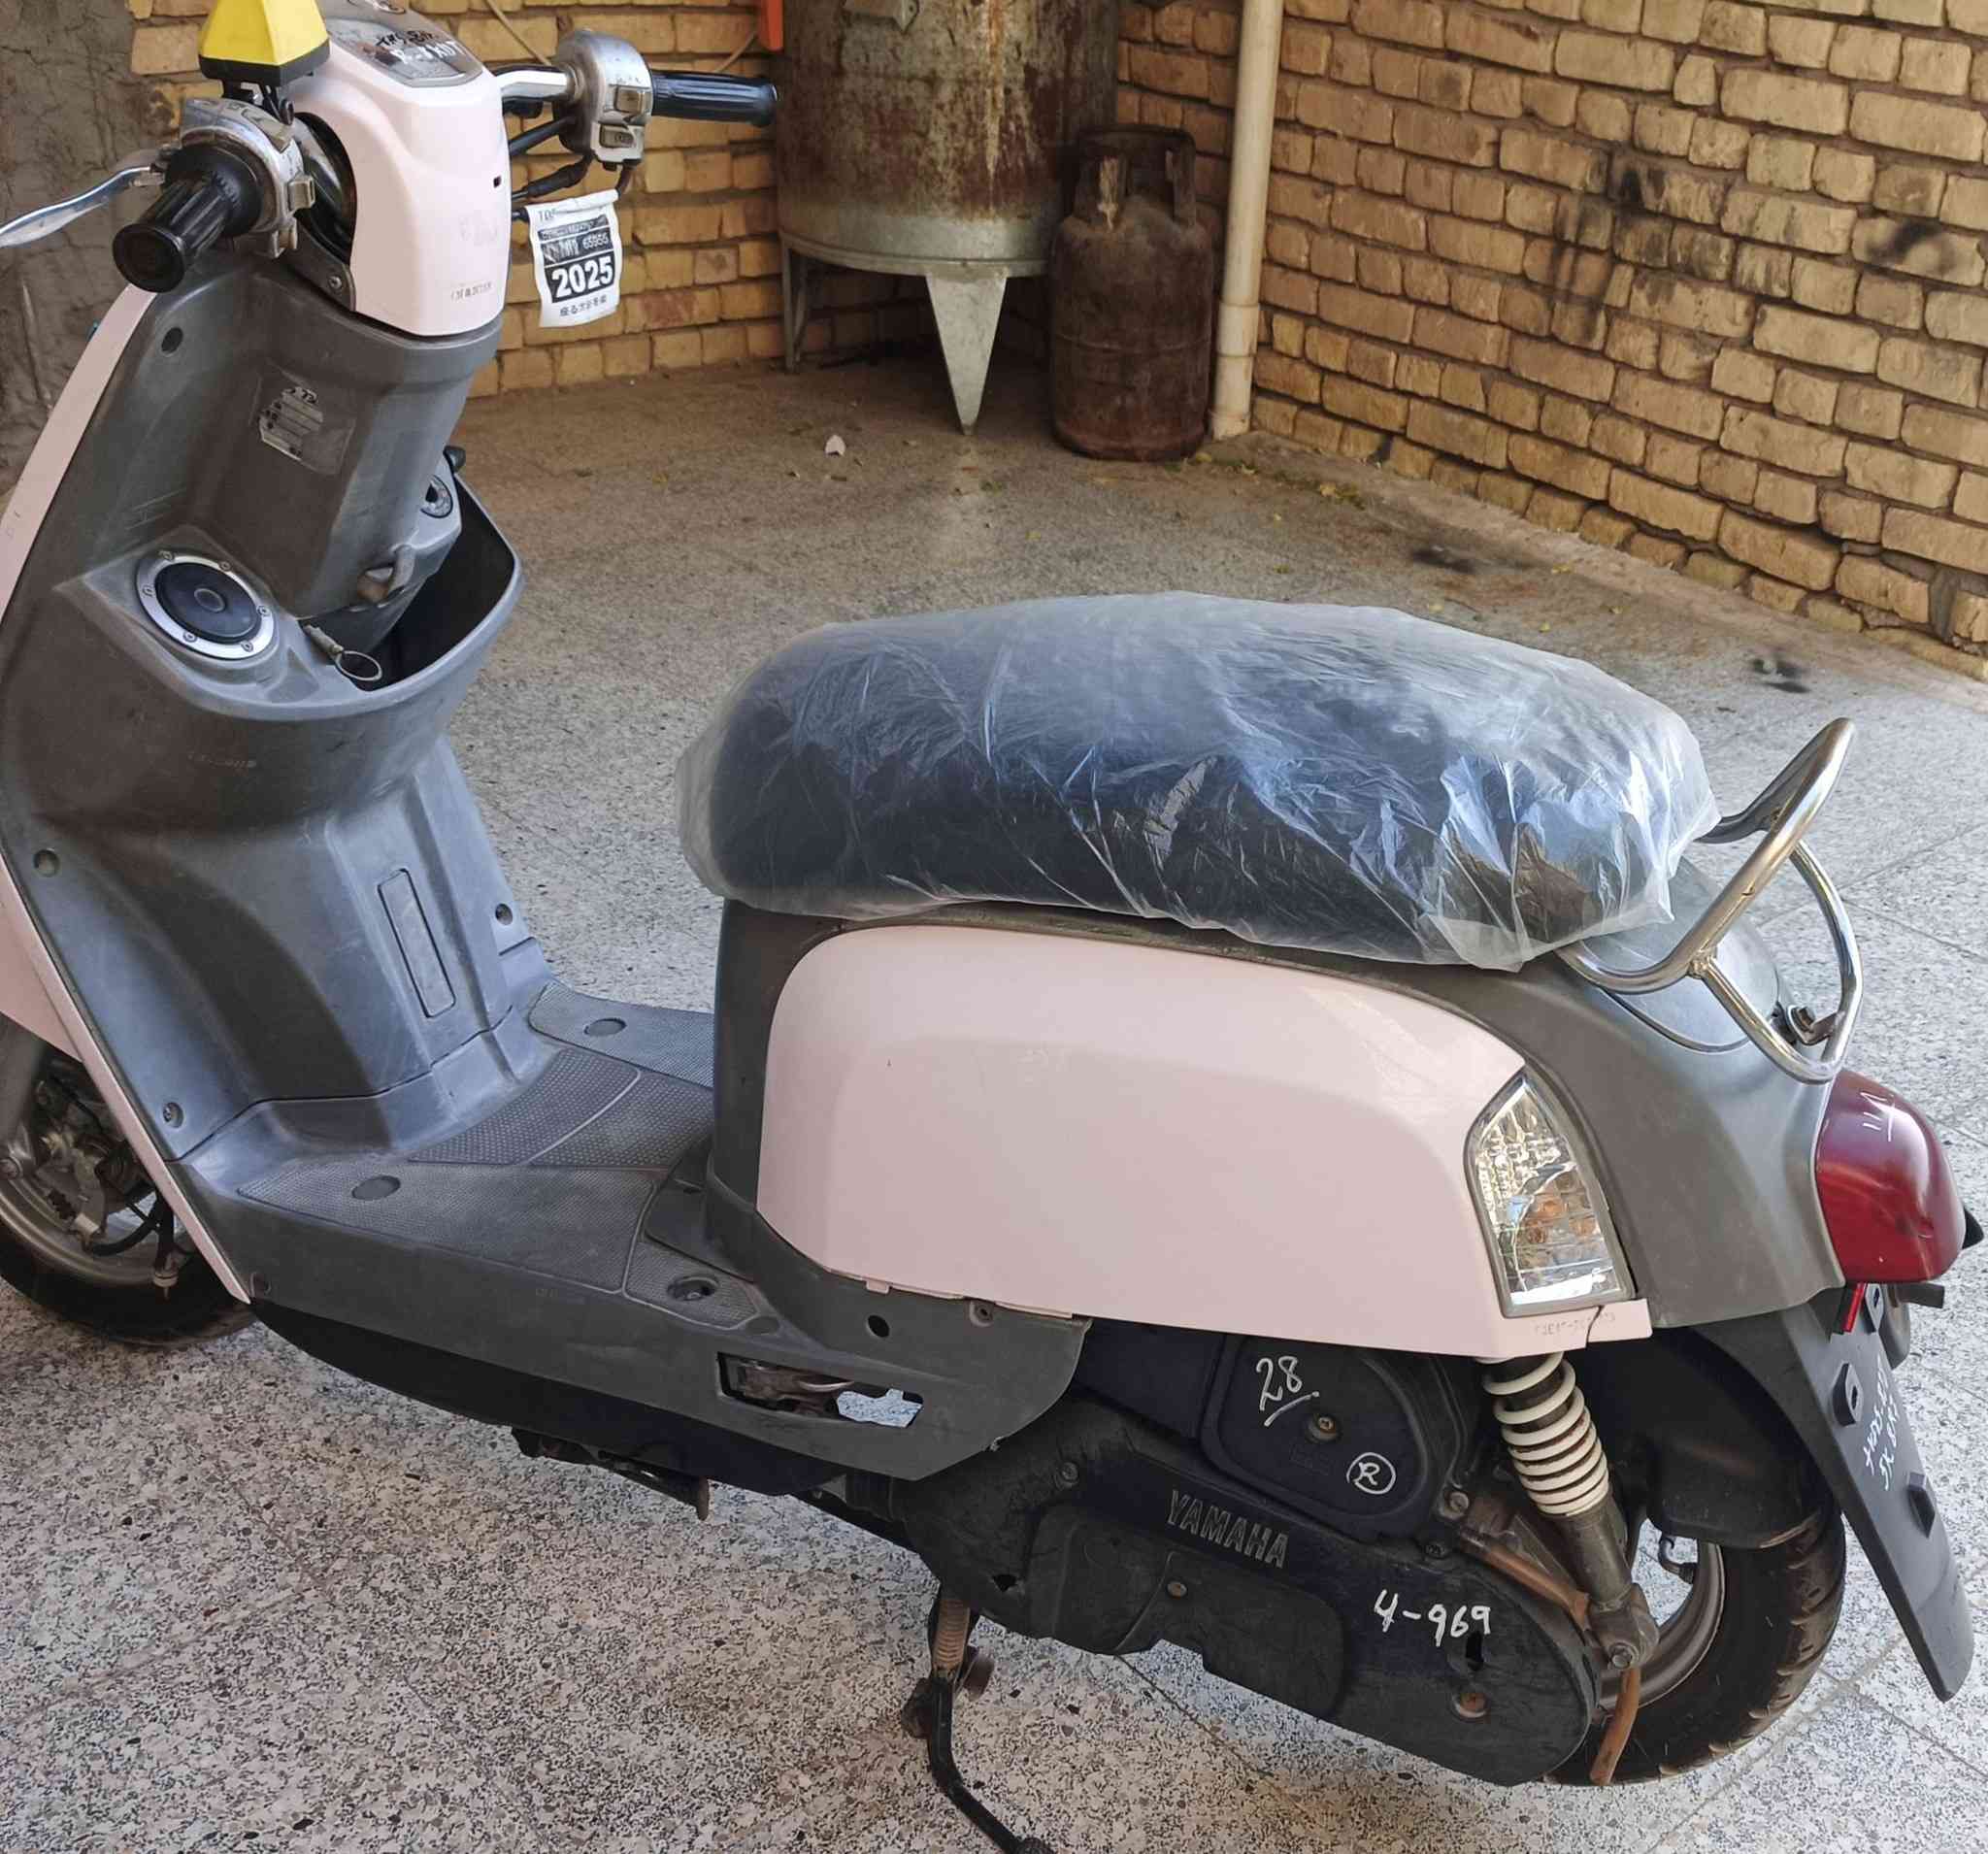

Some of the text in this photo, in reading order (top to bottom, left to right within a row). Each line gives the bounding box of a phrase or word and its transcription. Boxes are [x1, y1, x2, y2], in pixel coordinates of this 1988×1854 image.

[551, 255, 613, 298] 2025
[1255, 1355, 1303, 1410] 28
[1167, 1489, 1289, 1569] YAMAHA
[1374, 1588, 1491, 1647] 4-969
